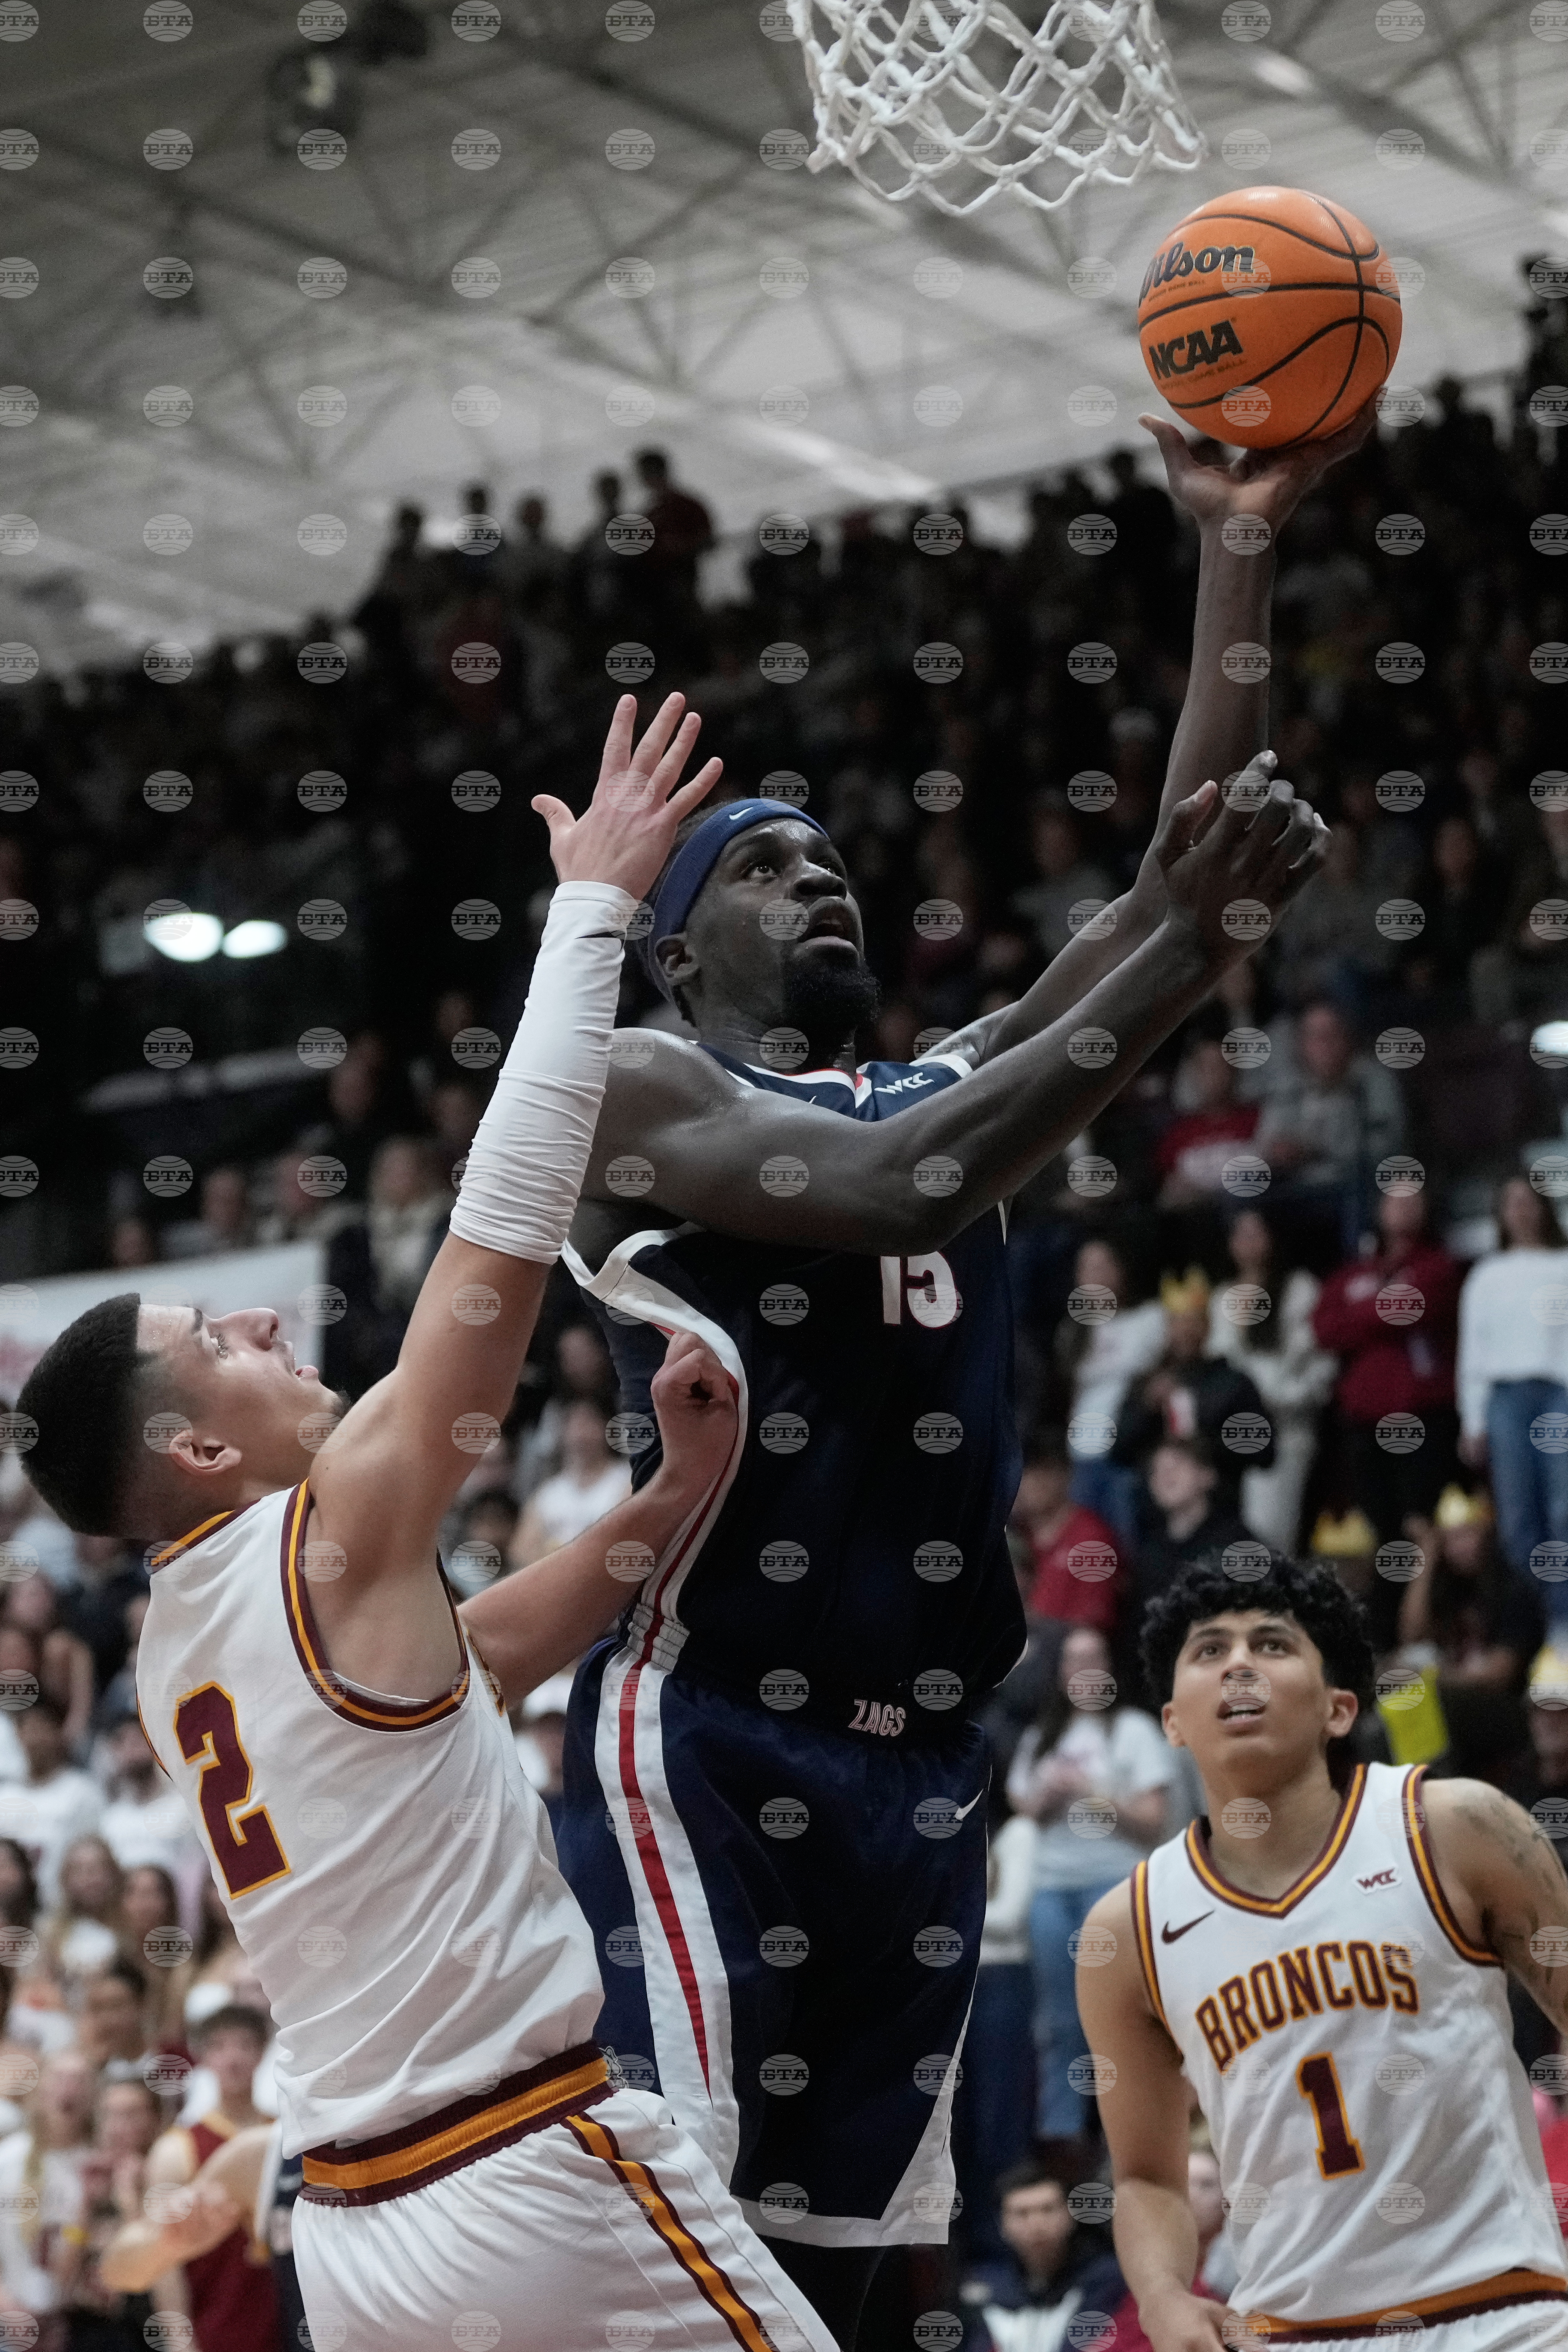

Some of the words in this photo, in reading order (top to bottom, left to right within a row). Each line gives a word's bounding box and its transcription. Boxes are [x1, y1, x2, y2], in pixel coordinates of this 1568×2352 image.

[1149, 320, 1244, 380] NCAA
[874, 1072, 935, 1095] WCC
[848, 1699, 907, 1737] ZAGS
[173, 1680, 292, 1900] 2
[1195, 1941, 1420, 2075] BRONCOS
[1295, 2052, 1366, 2180] 1
